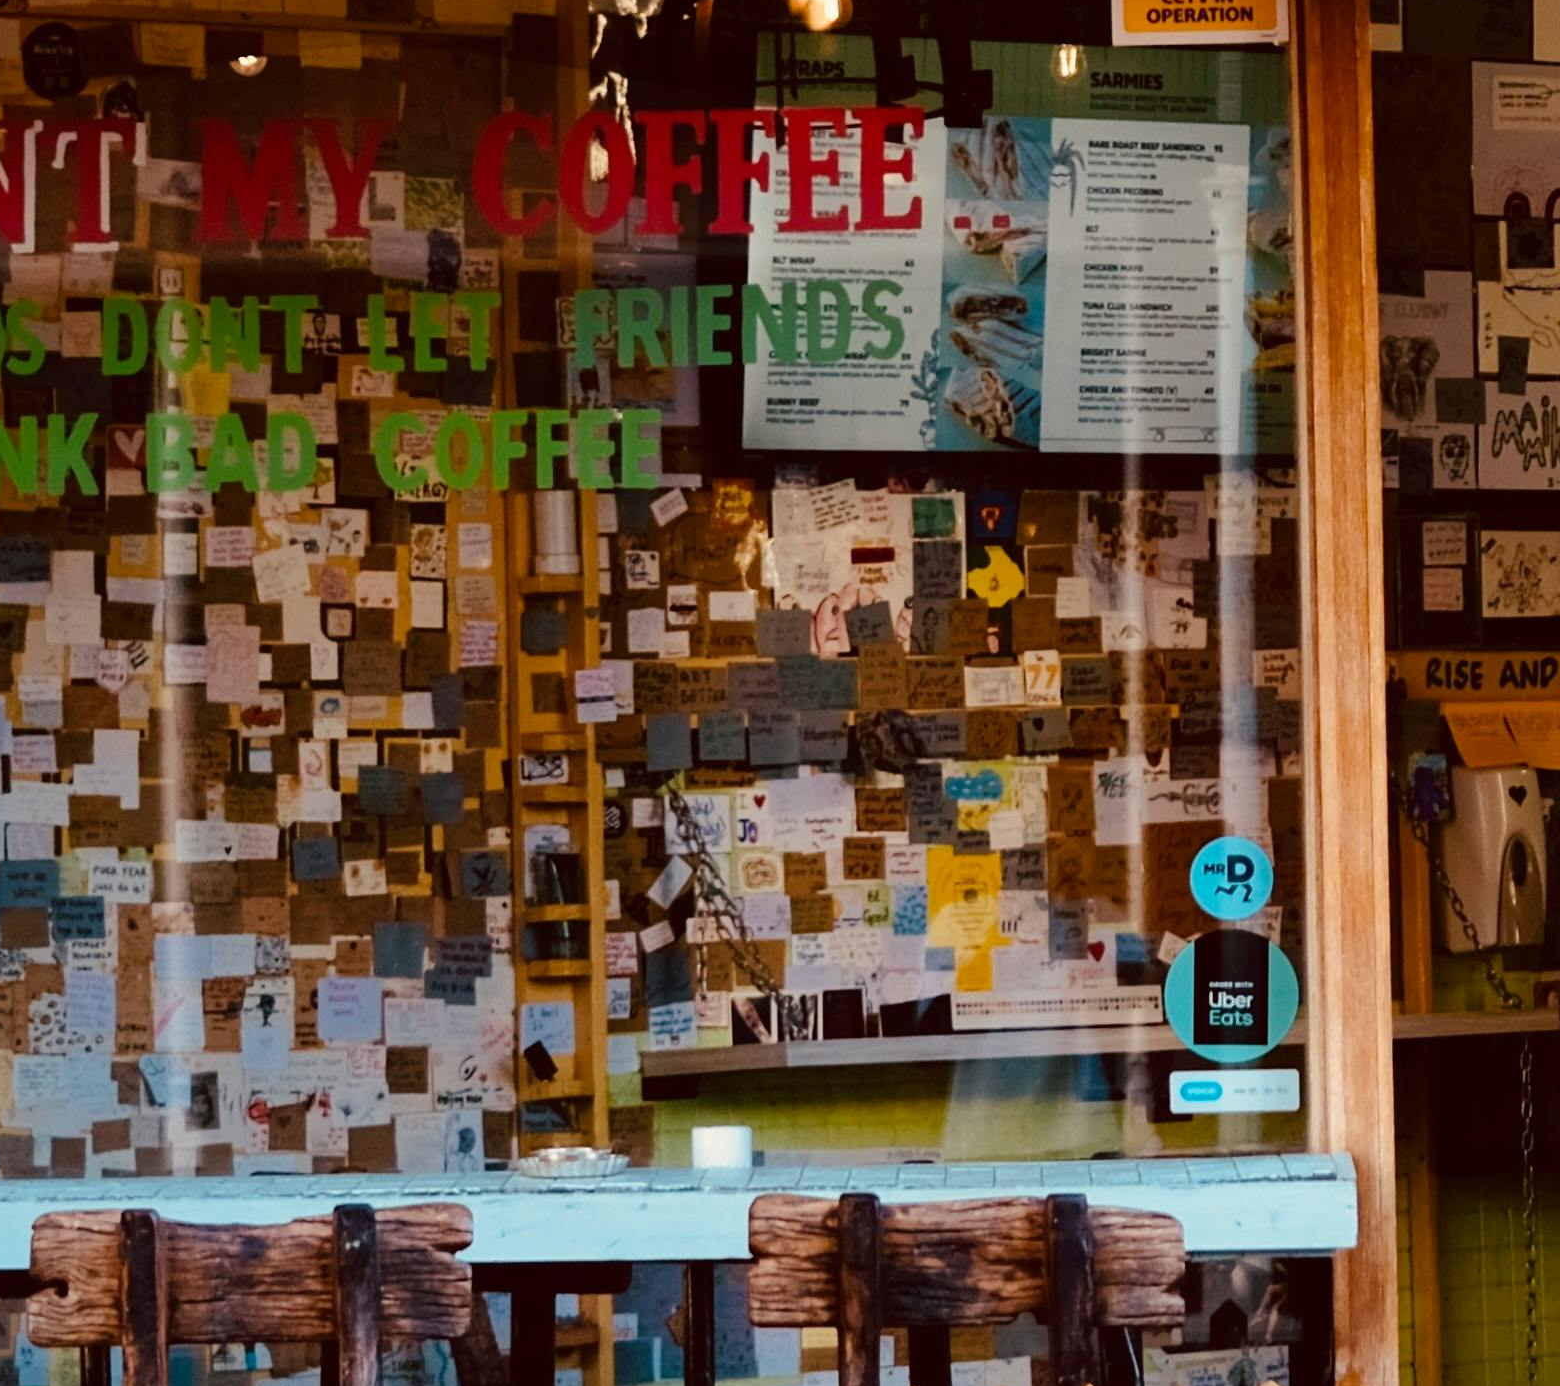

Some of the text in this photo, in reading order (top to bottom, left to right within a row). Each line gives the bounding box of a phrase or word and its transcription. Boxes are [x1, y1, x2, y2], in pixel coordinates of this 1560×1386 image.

[1146, 6, 1253, 24] OPERATION
[1090, 71, 1164, 90] SARMIES
[196, 116, 392, 244] MY
[473, 106, 926, 240] COFFEE
[102, 293, 320, 376] DONT
[368, 291, 502, 373] LET
[574, 280, 907, 369] FRIENDS
[147, 412, 320, 494] BAD
[374, 409, 662, 493] COFFEE
[1425, 658, 1482, 689] RISE
[1500, 658, 1558, 689] AND
[1204, 854, 1254, 883] MR D
[1208, 990, 1254, 1008] Uber
[1208, 1009, 1254, 1027] Eats
